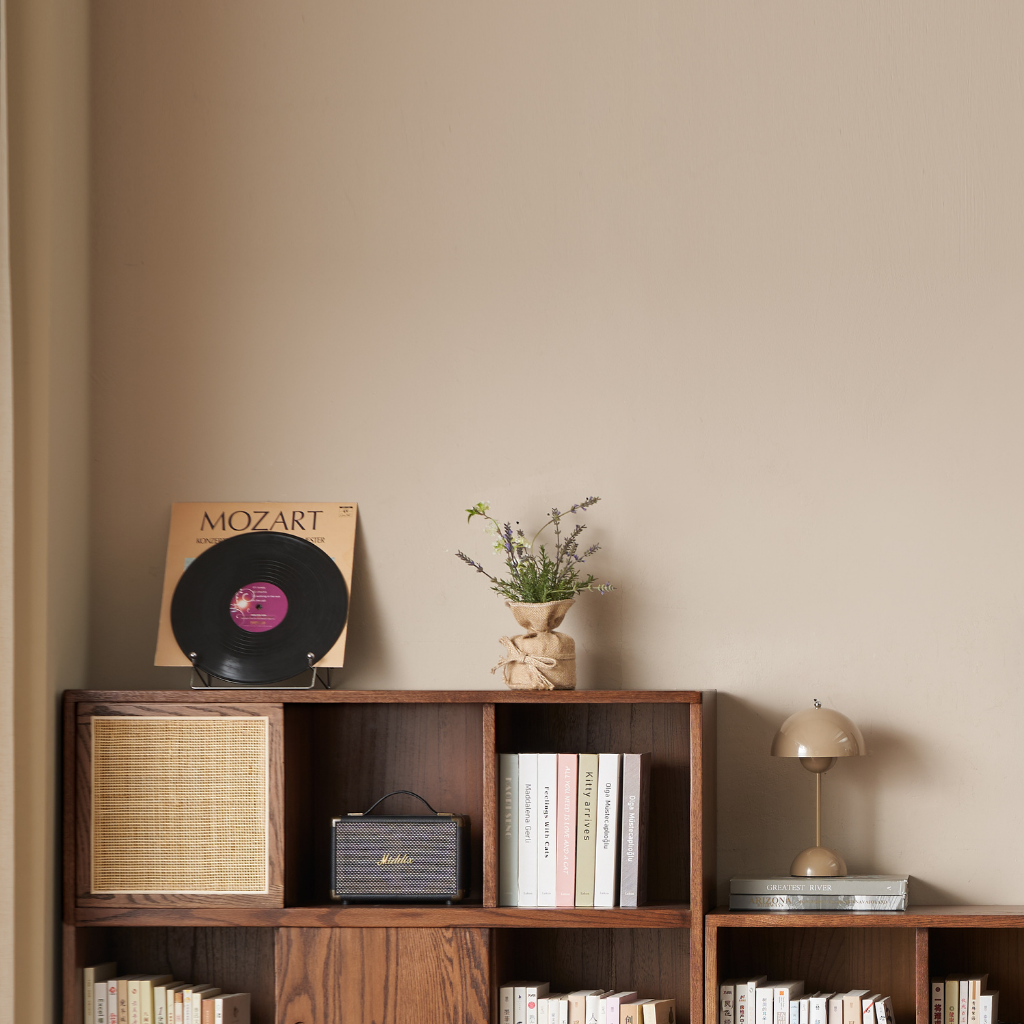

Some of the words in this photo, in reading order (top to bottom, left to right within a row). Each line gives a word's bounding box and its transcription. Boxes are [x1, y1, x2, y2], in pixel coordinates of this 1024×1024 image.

[200, 510, 323, 531] MOZART
[583, 771, 593, 797] Kitty
[603, 782, 612, 798] Olga
[563, 795, 571, 813] NEED
[628, 795, 636, 810] Olga
[583, 801, 592, 841] arrives
[749, 896, 792, 904] ARIZONA
